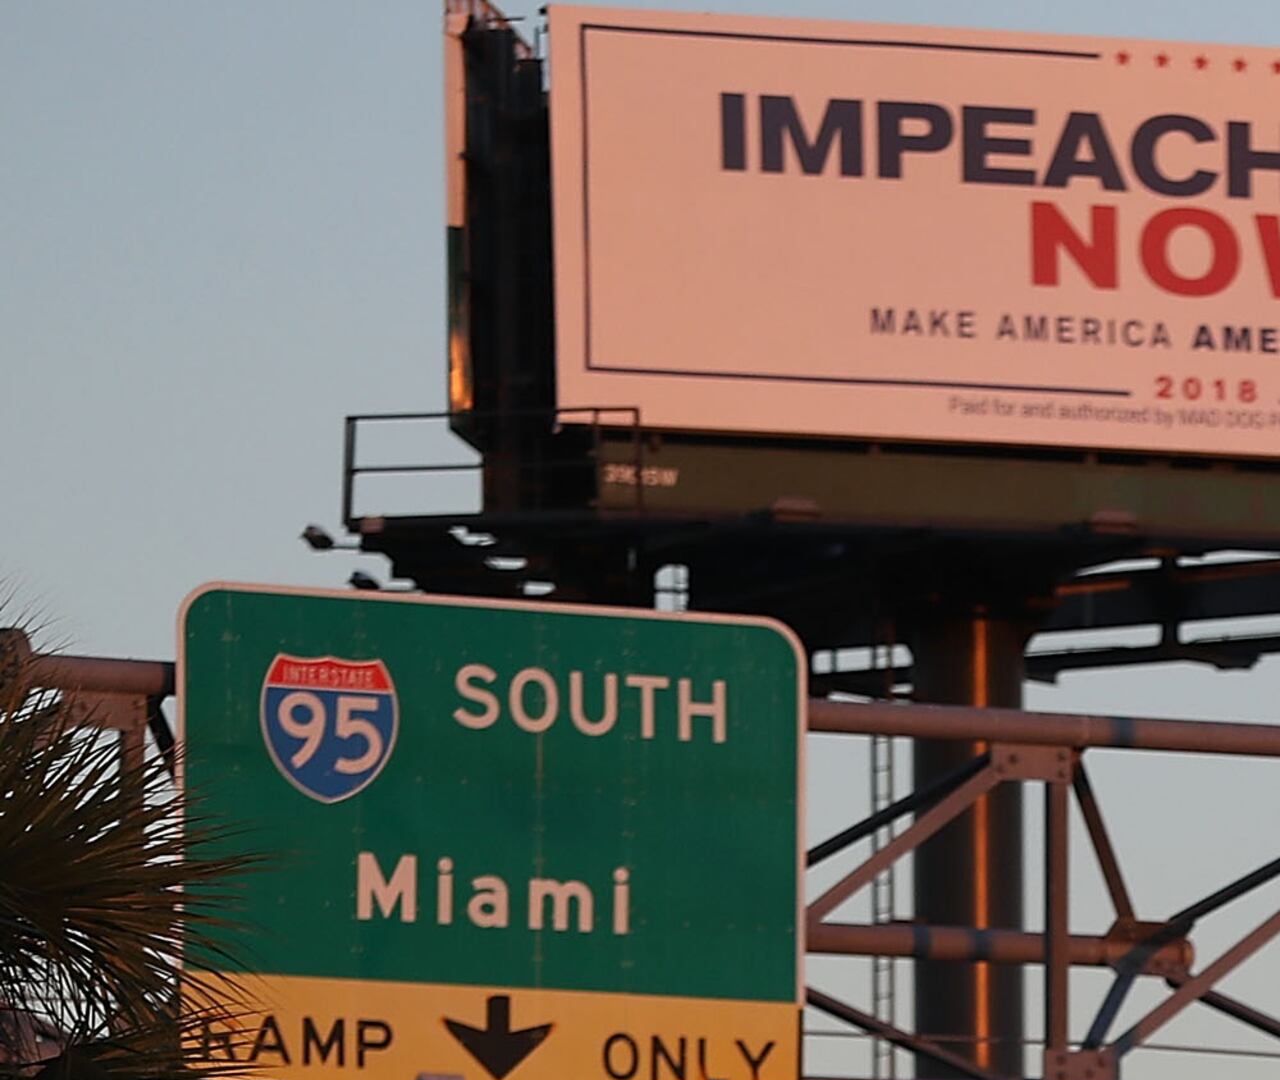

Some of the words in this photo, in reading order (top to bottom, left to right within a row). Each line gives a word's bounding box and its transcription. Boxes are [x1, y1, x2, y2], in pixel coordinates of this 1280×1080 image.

[870, 307, 977, 338] MAKE
[996, 314, 1172, 349] AMERICA
[1155, 376, 1258, 403] 2018
[949, 398, 987, 416] Paid
[993, 399, 1014, 417] for
[1023, 401, 1055, 419] and
[1060, 403, 1150, 425] authorized
[1156, 407, 1174, 429] by
[1179, 408, 1221, 428] MAD
[283, 664, 375, 687] INTERSTATE
[454, 664, 727, 744] SOUTH
[278, 691, 383, 774] 95
[357, 851, 631, 935] Miami
